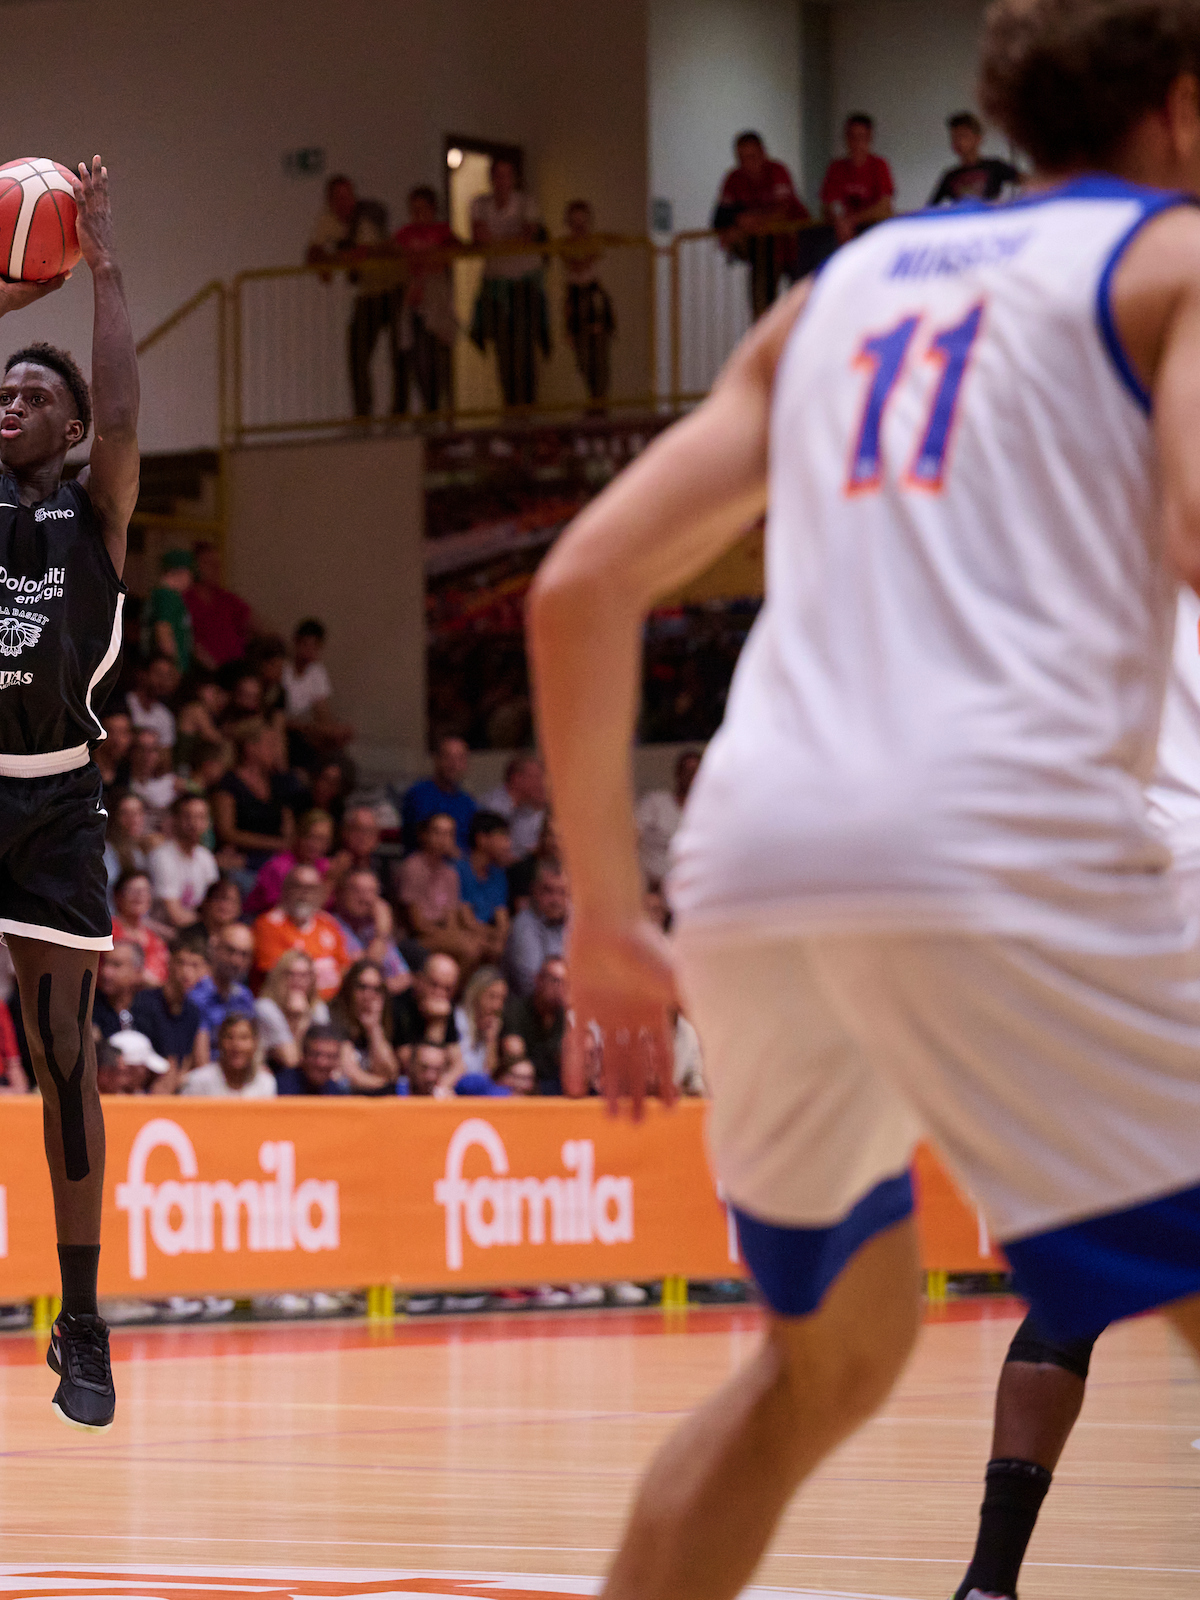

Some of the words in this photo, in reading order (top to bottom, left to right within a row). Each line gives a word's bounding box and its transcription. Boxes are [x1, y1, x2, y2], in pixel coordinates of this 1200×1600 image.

[844, 296, 986, 497] 11
[11, 607, 50, 626] BASKET
[116, 1118, 340, 1279] famila
[433, 1117, 634, 1270] famila
